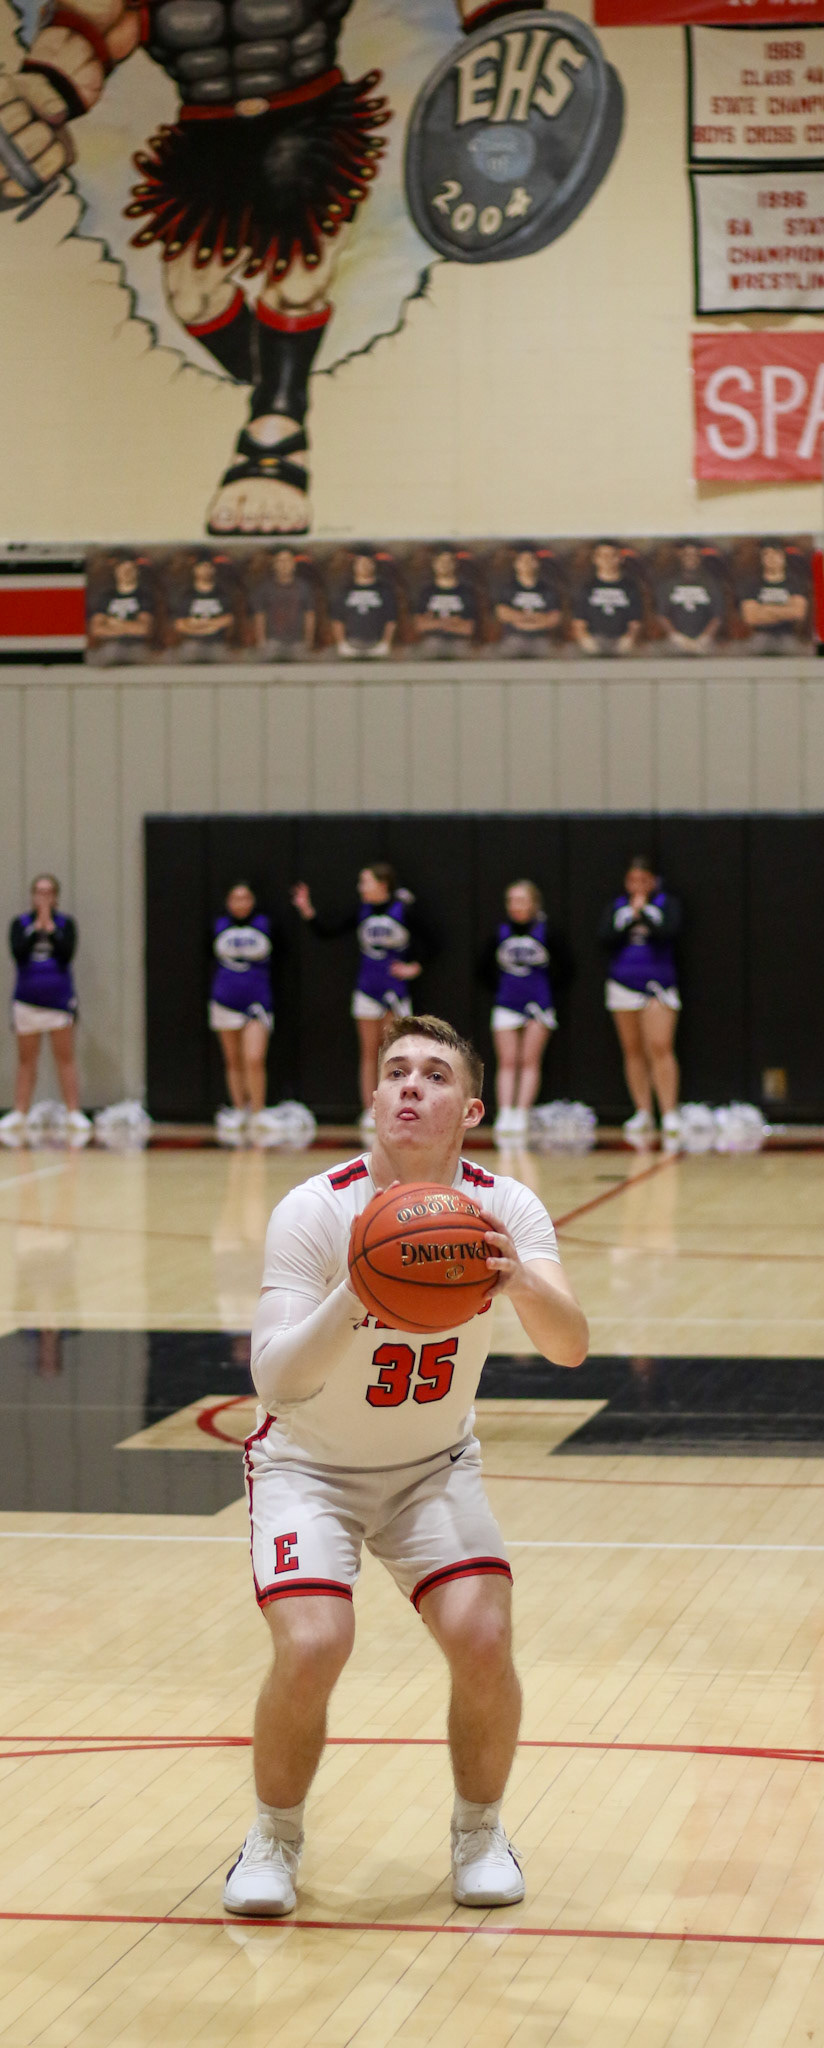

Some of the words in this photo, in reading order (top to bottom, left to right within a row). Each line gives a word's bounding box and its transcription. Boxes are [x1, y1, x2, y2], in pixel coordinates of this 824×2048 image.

[456, 29, 586, 124] EHS
[741, 69, 793, 86] CLASS
[711, 96, 756, 115] STATE
[744, 125, 796, 144] CROSS
[432, 180, 532, 235] 2004
[365, 1337, 458, 1408] 35
[274, 1532, 299, 1575] E
